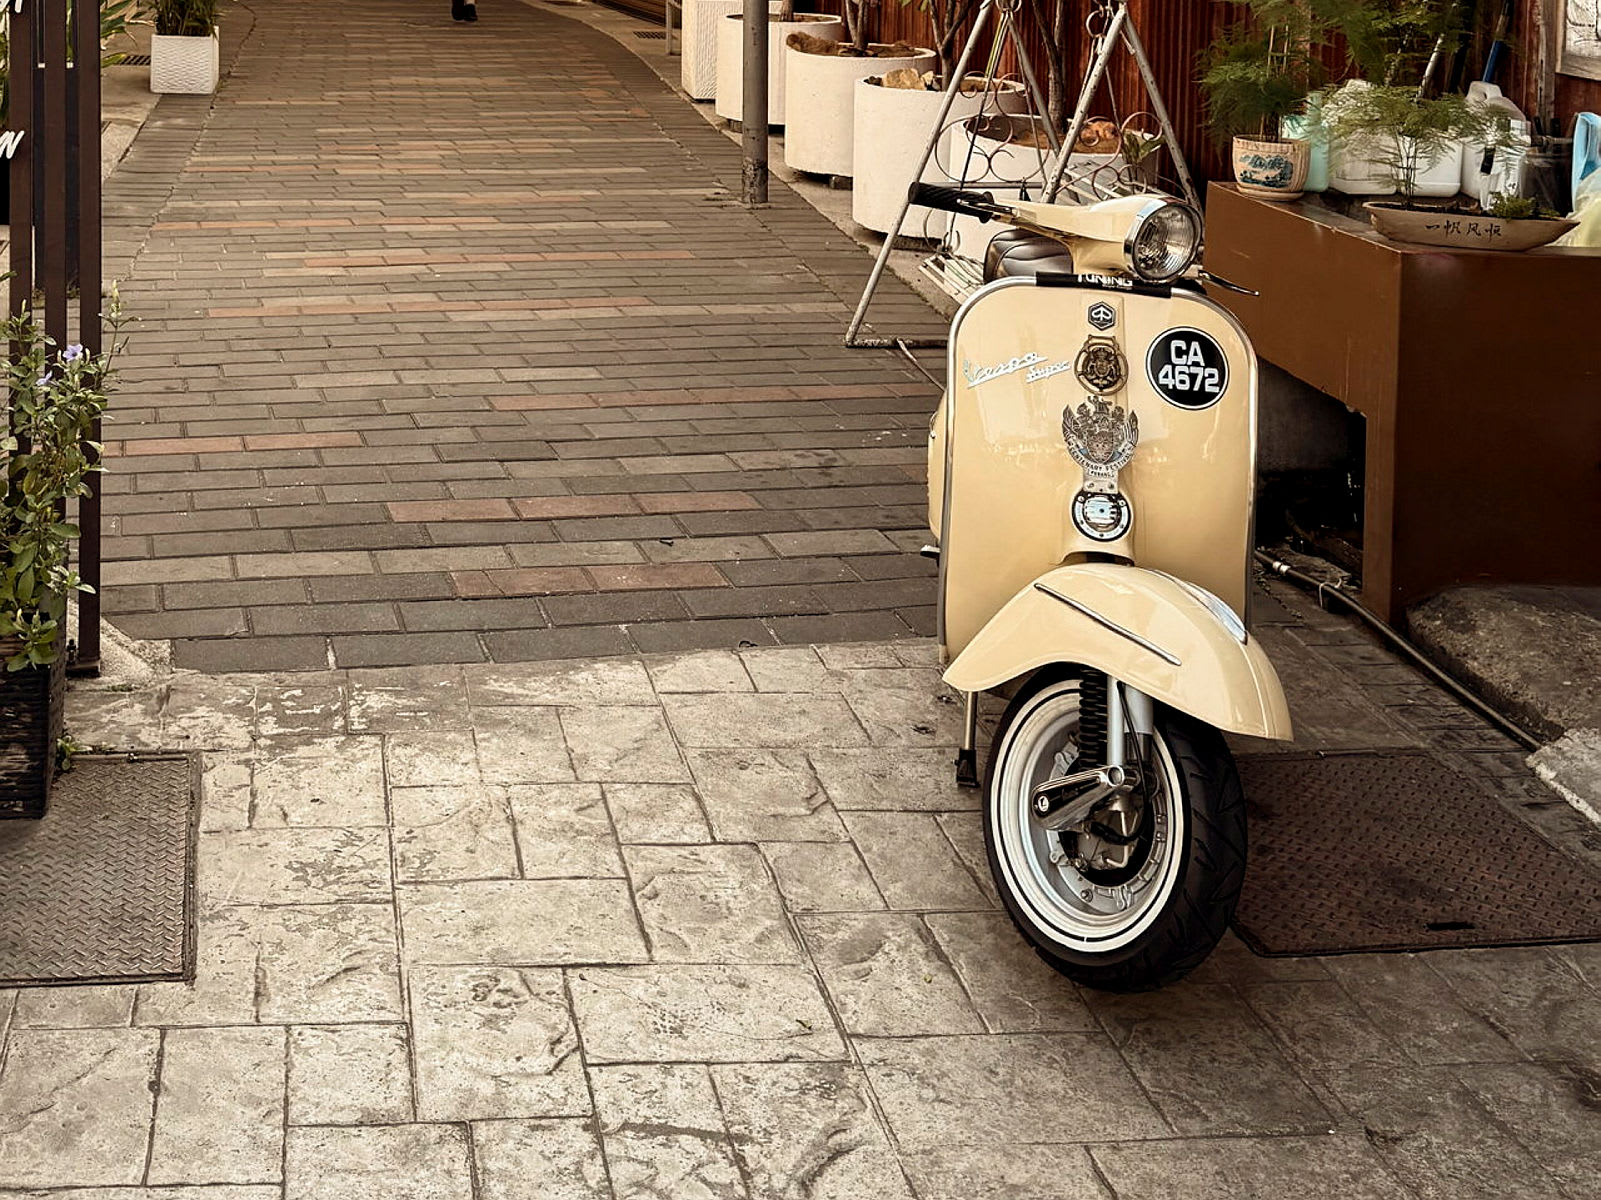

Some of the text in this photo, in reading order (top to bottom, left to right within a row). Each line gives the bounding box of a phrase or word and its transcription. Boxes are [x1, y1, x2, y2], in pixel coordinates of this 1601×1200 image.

[1170, 340, 1205, 366] CA
[963, 351, 1048, 390] Vespa
[1158, 364, 1220, 393] 4672
